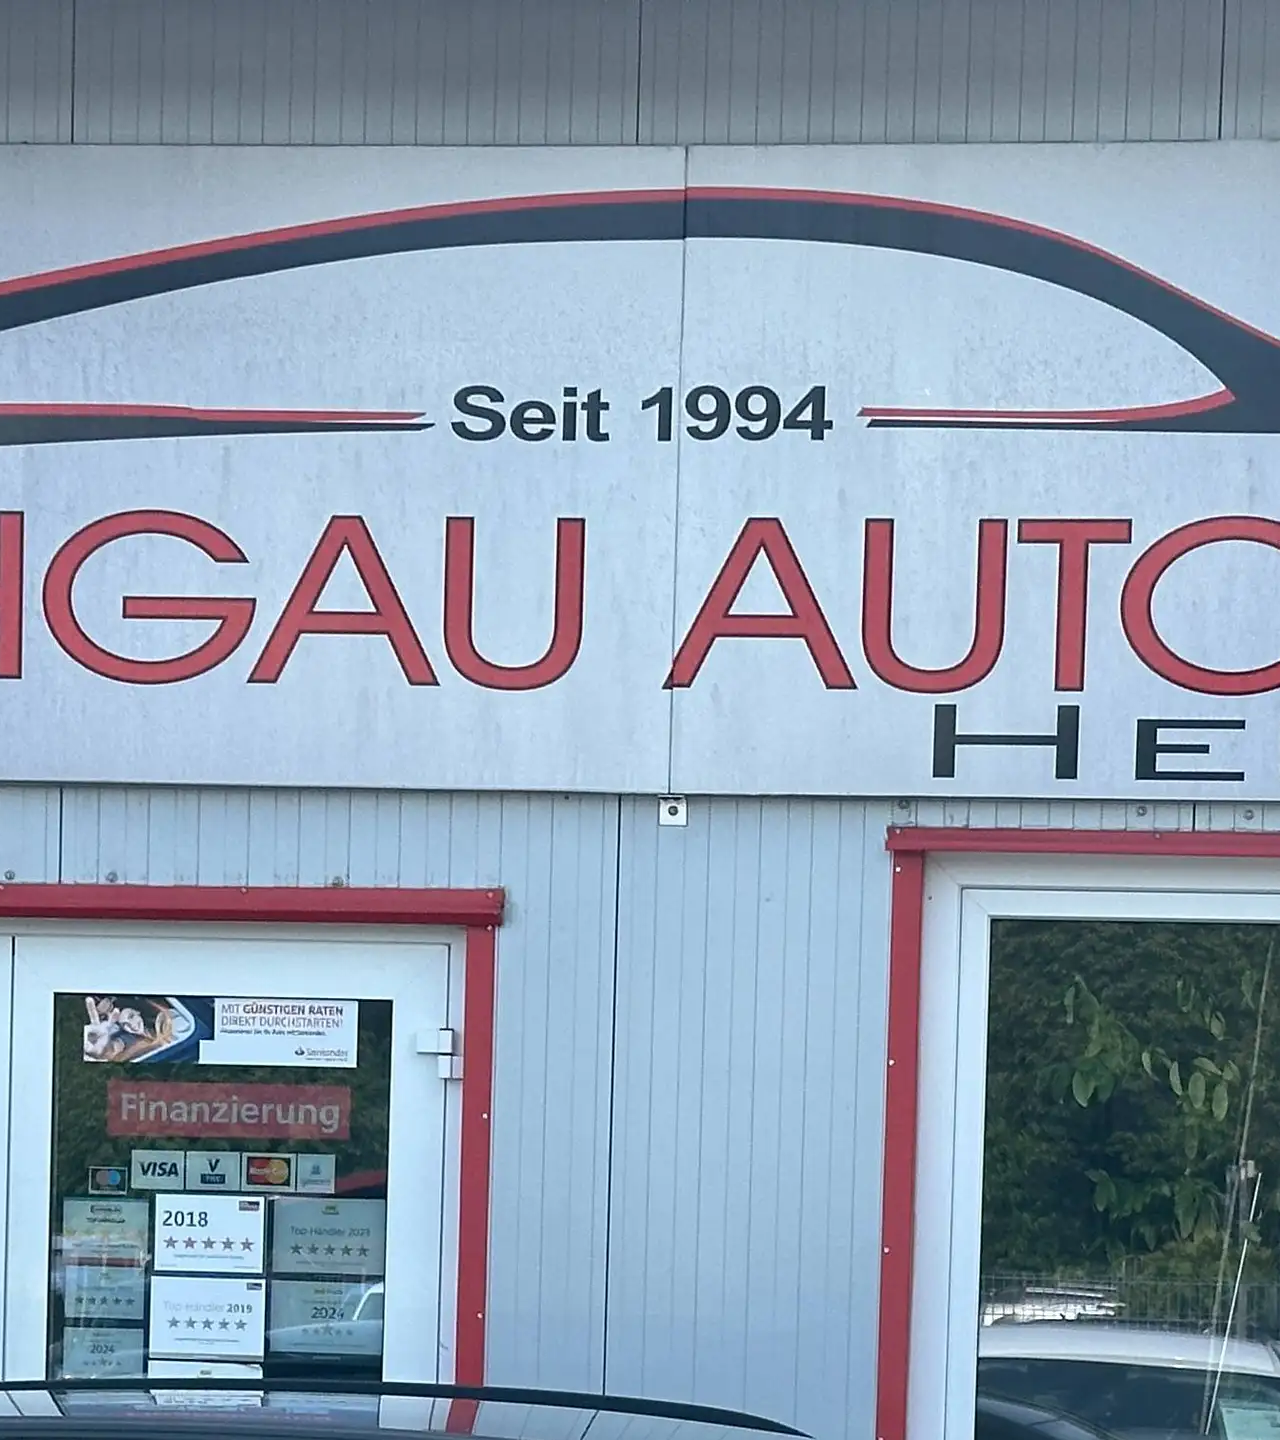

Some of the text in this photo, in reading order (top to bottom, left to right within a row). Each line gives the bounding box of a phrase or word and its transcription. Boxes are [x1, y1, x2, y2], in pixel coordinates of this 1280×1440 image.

[450, 384, 834, 442] Seit 1994
[308, 1006, 343, 1016] RATEN
[221, 1016, 257, 1026] DIREKT
[120, 1092, 340, 1133] Finanzierung
[140, 1160, 180, 1178] VISA
[162, 1210, 209, 1228] 2018
[226, 1303, 253, 1314] 2019
